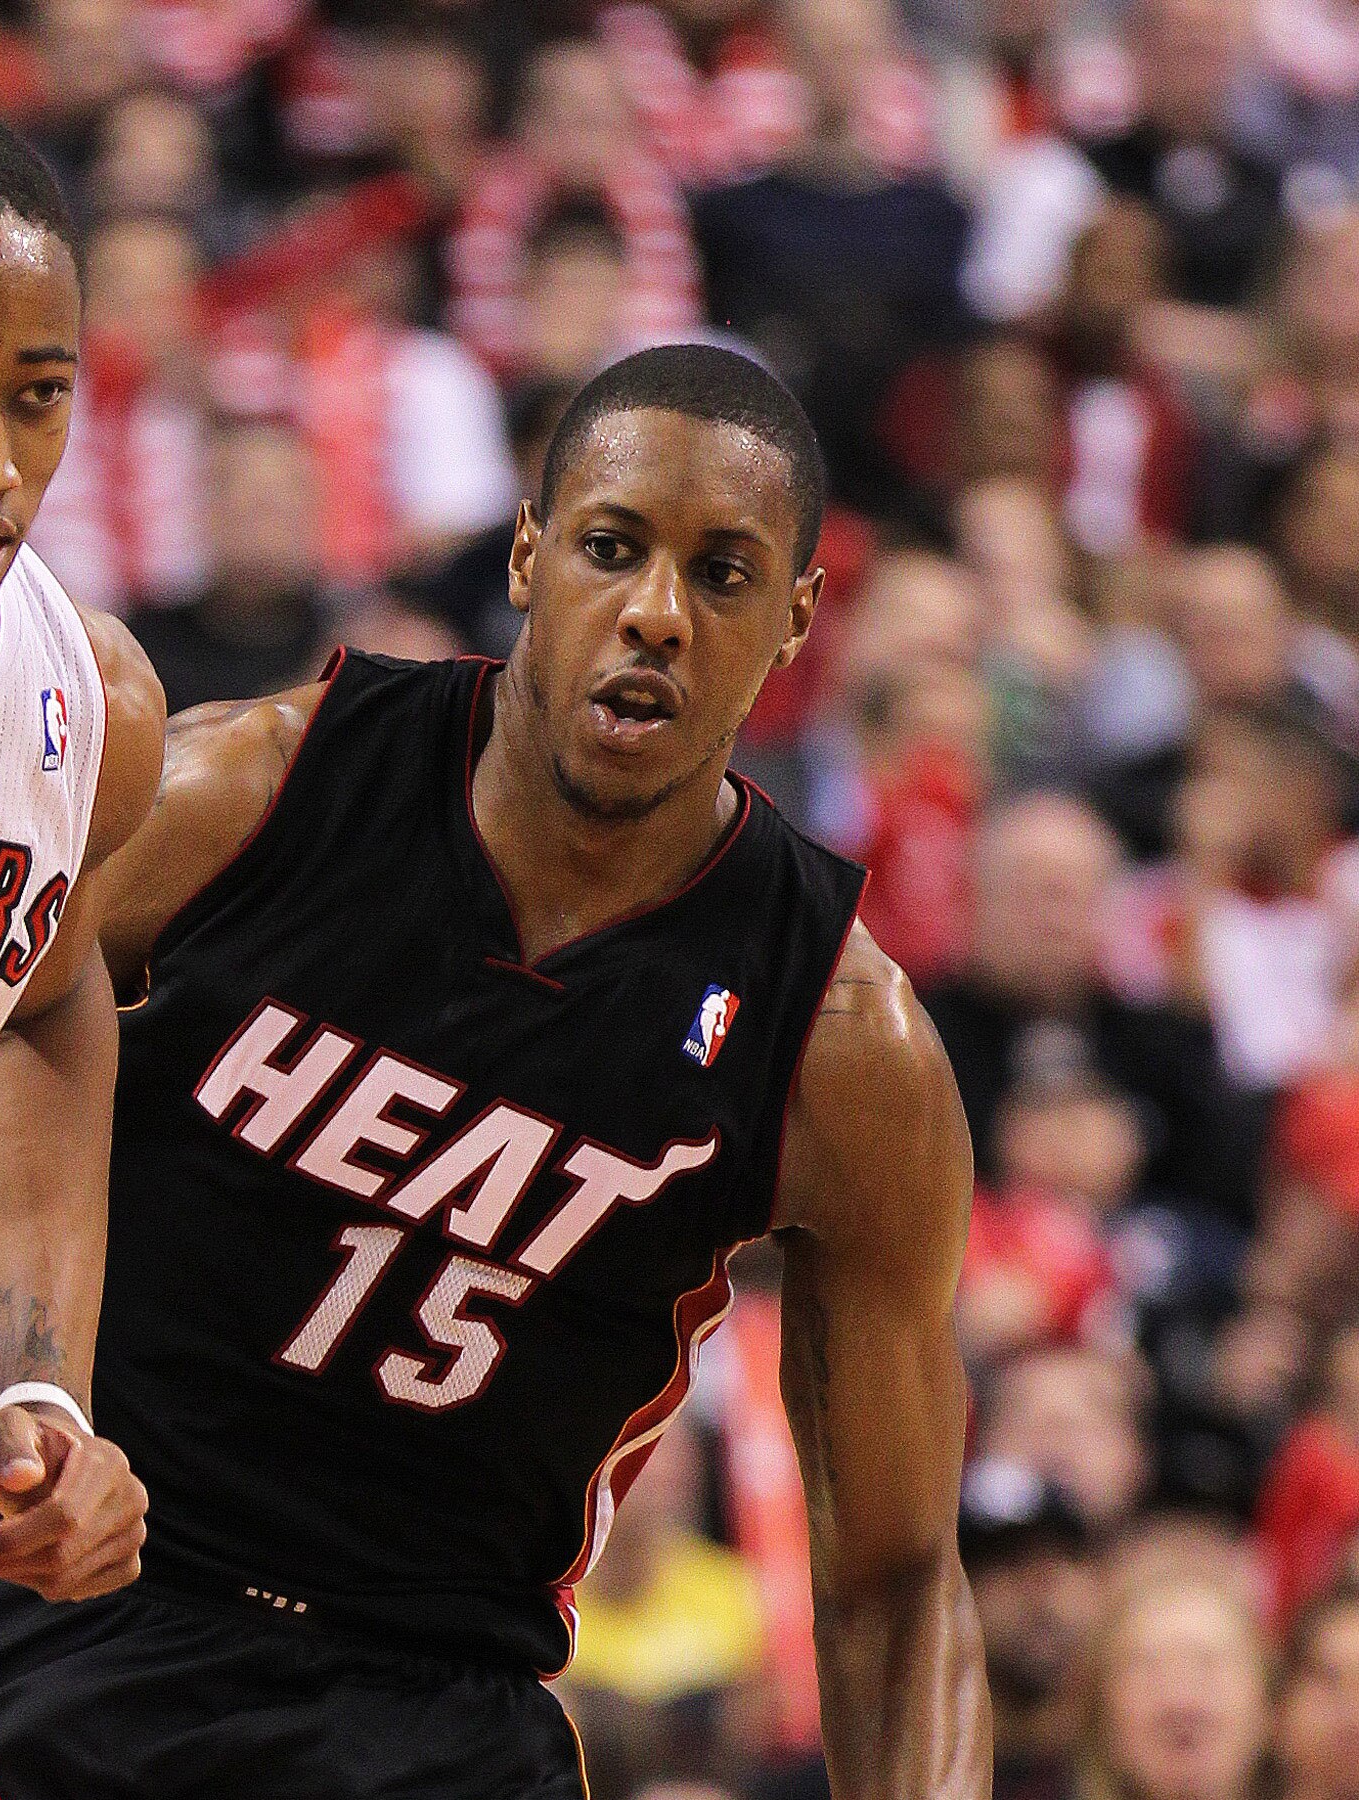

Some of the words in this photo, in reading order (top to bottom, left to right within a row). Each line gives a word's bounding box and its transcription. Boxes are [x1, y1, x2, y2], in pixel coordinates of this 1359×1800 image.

[192, 995, 722, 1281] HEAT
[682, 1038, 705, 1060] NBA
[272, 1220, 534, 1414] 15
